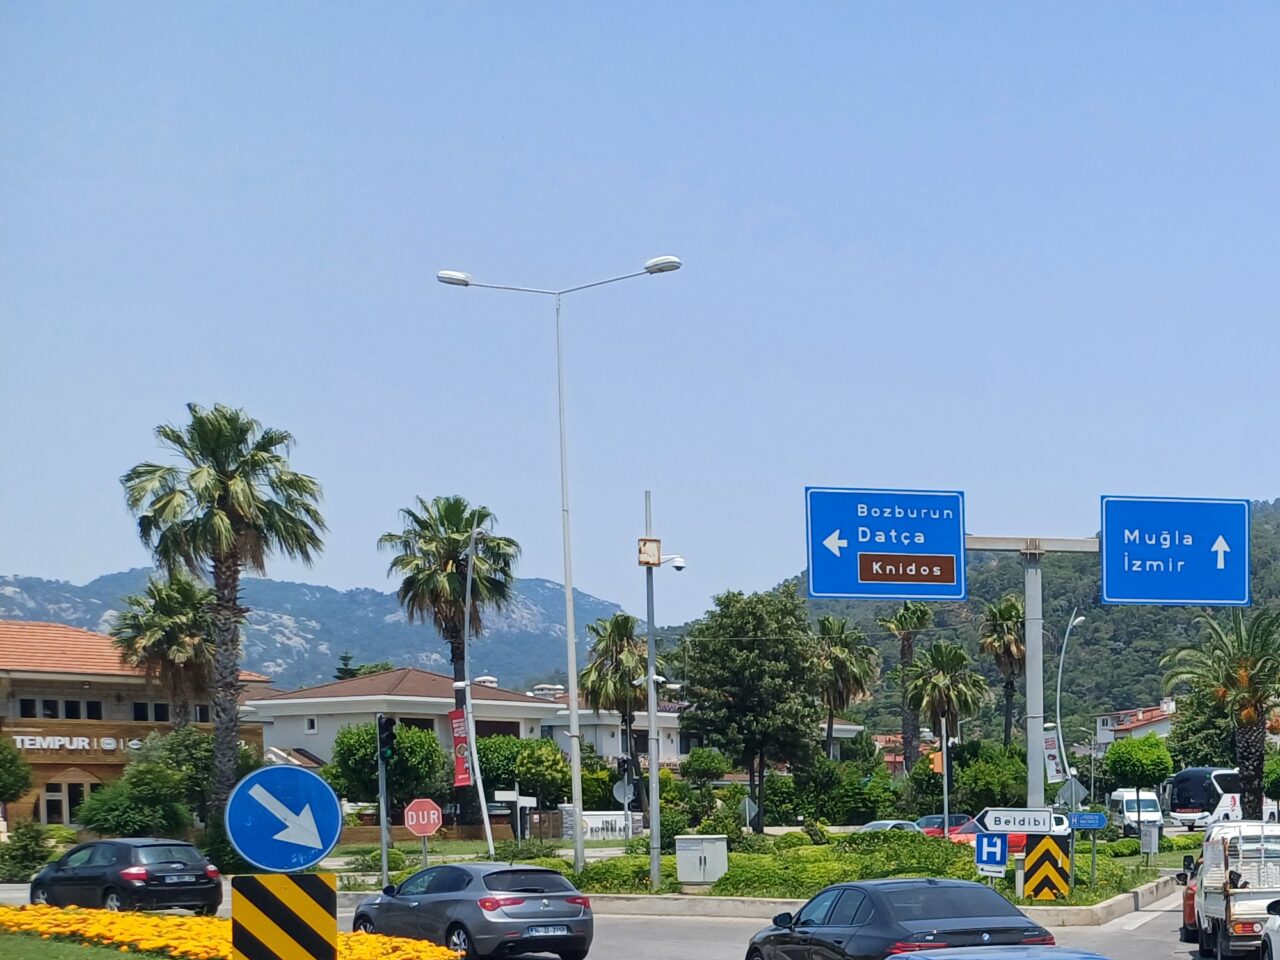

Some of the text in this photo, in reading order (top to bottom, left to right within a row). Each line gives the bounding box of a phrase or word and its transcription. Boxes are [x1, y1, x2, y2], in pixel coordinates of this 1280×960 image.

[857, 504, 953, 519] Bozburun
[857, 526, 925, 546] Datça
[1124, 529, 1193, 549] Muğla
[872, 561, 941, 576] Knidos
[1124, 552, 1185, 572] İzmir
[12, 736, 90, 750] TEMPUR
[408, 810, 439, 825] DUR
[993, 817, 1046, 826] Beldibi
